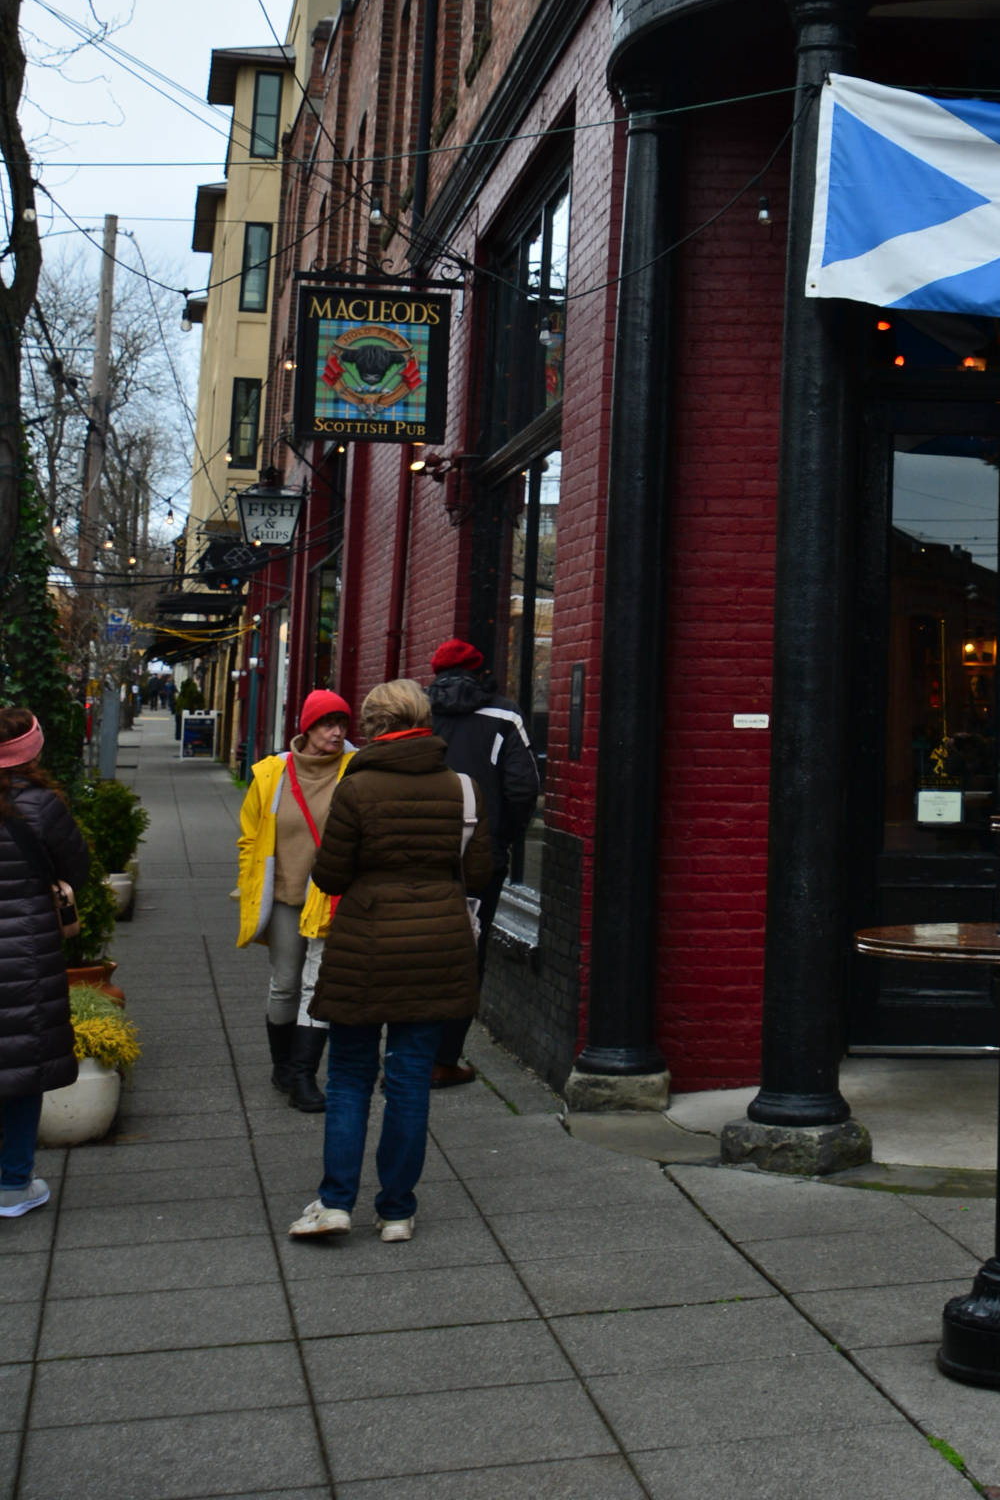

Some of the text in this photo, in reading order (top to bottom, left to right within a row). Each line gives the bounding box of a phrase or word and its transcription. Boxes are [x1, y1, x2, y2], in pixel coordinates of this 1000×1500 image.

[308, 296, 441, 325] MACLEOD'S
[313, 418, 426, 436] SCOTTISH PUB
[247, 502, 295, 517] FISH
[264, 517, 277, 529] &
[251, 531, 289, 540] CHIPS
